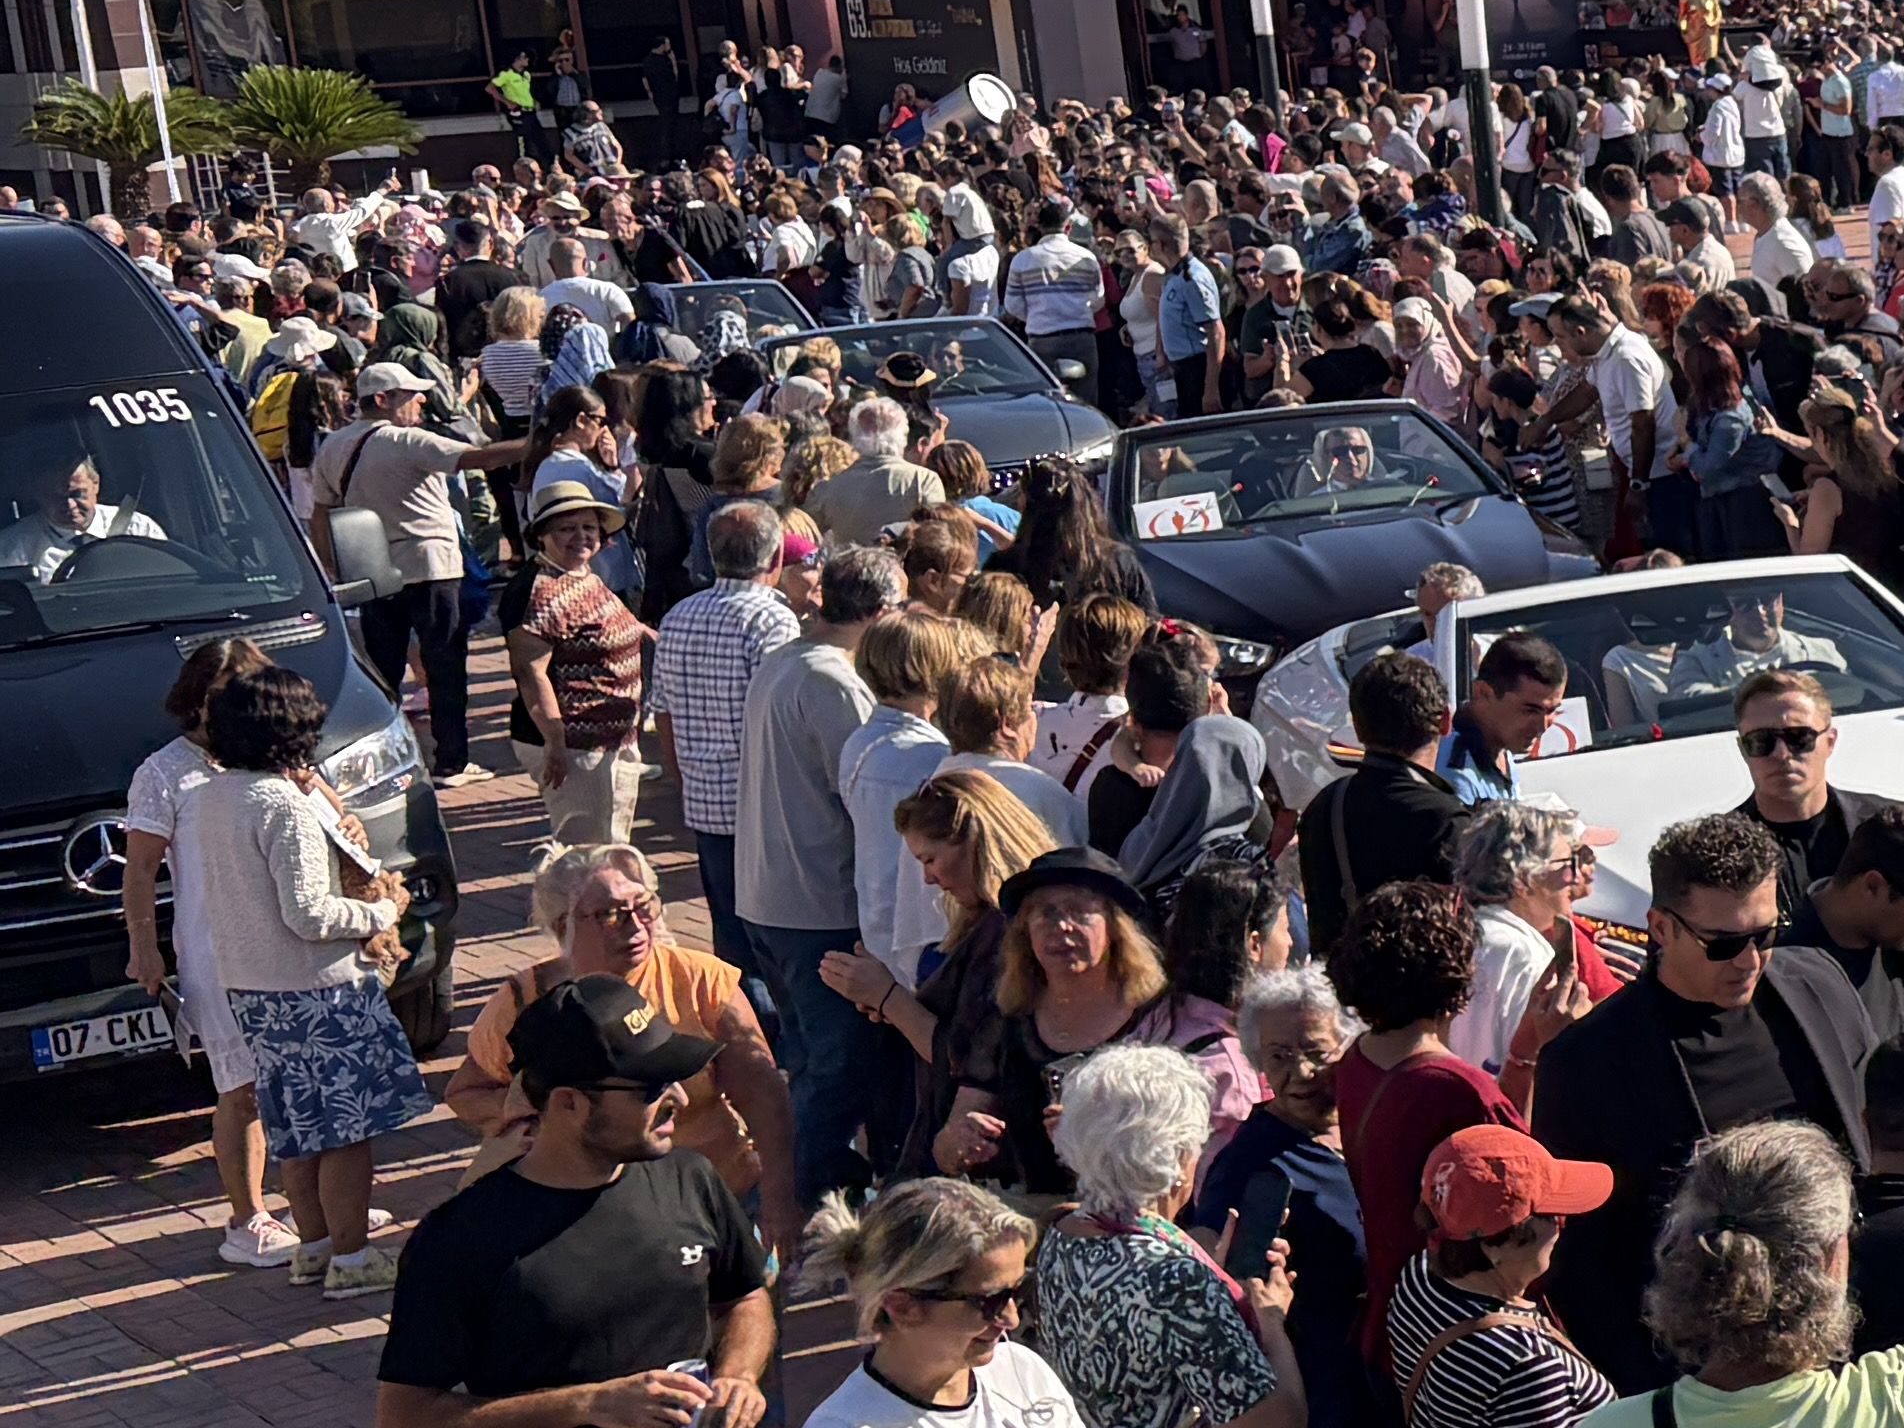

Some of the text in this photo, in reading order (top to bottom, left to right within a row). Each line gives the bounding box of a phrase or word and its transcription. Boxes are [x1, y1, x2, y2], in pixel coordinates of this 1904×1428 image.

[89, 388, 193, 428] 1035
[52, 1023, 90, 1058] 07
[107, 1011, 168, 1046] CKL
